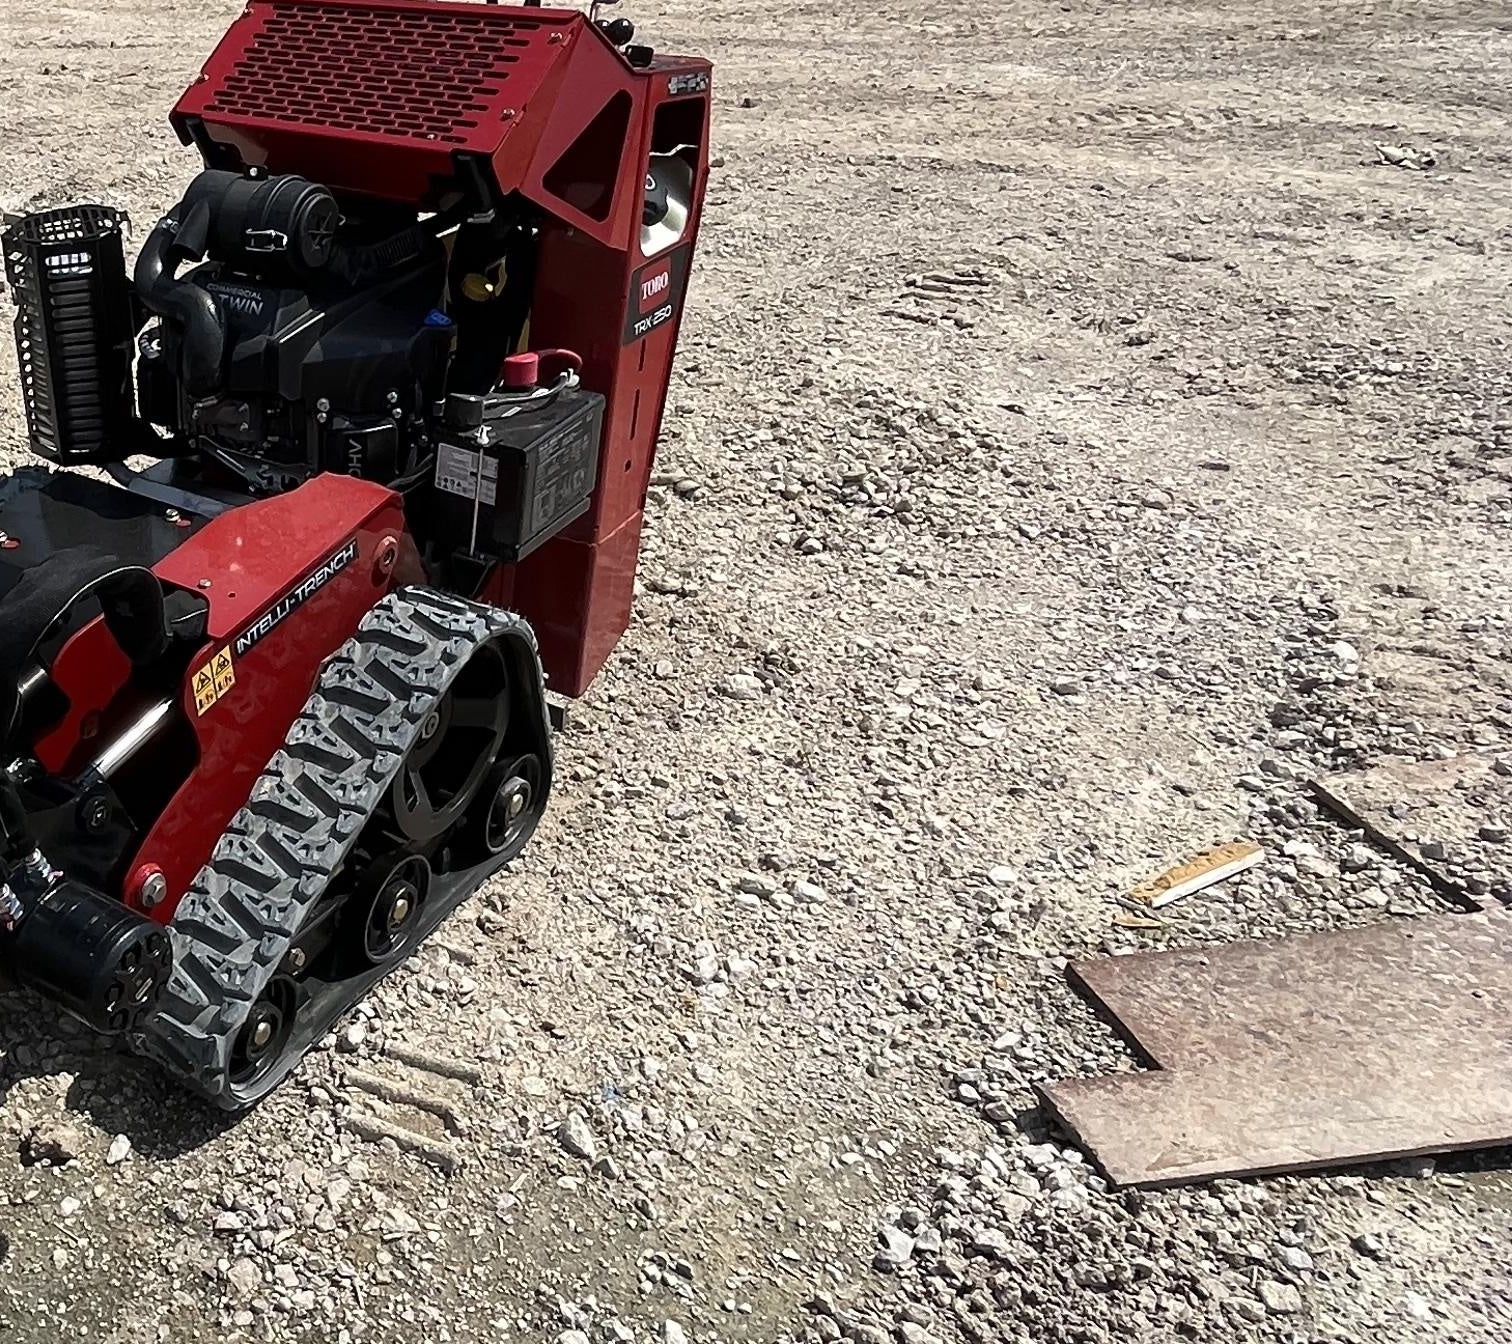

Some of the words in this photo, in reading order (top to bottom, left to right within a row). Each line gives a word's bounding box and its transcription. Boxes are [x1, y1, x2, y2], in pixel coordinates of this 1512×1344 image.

[206, 282, 262, 300] COMMERCIAL
[641, 271, 669, 300] TORO
[219, 293, 264, 316] TWIN
[633, 304, 673, 336] TRX-250
[236, 543, 355, 654] INTELLI-TRENCH
